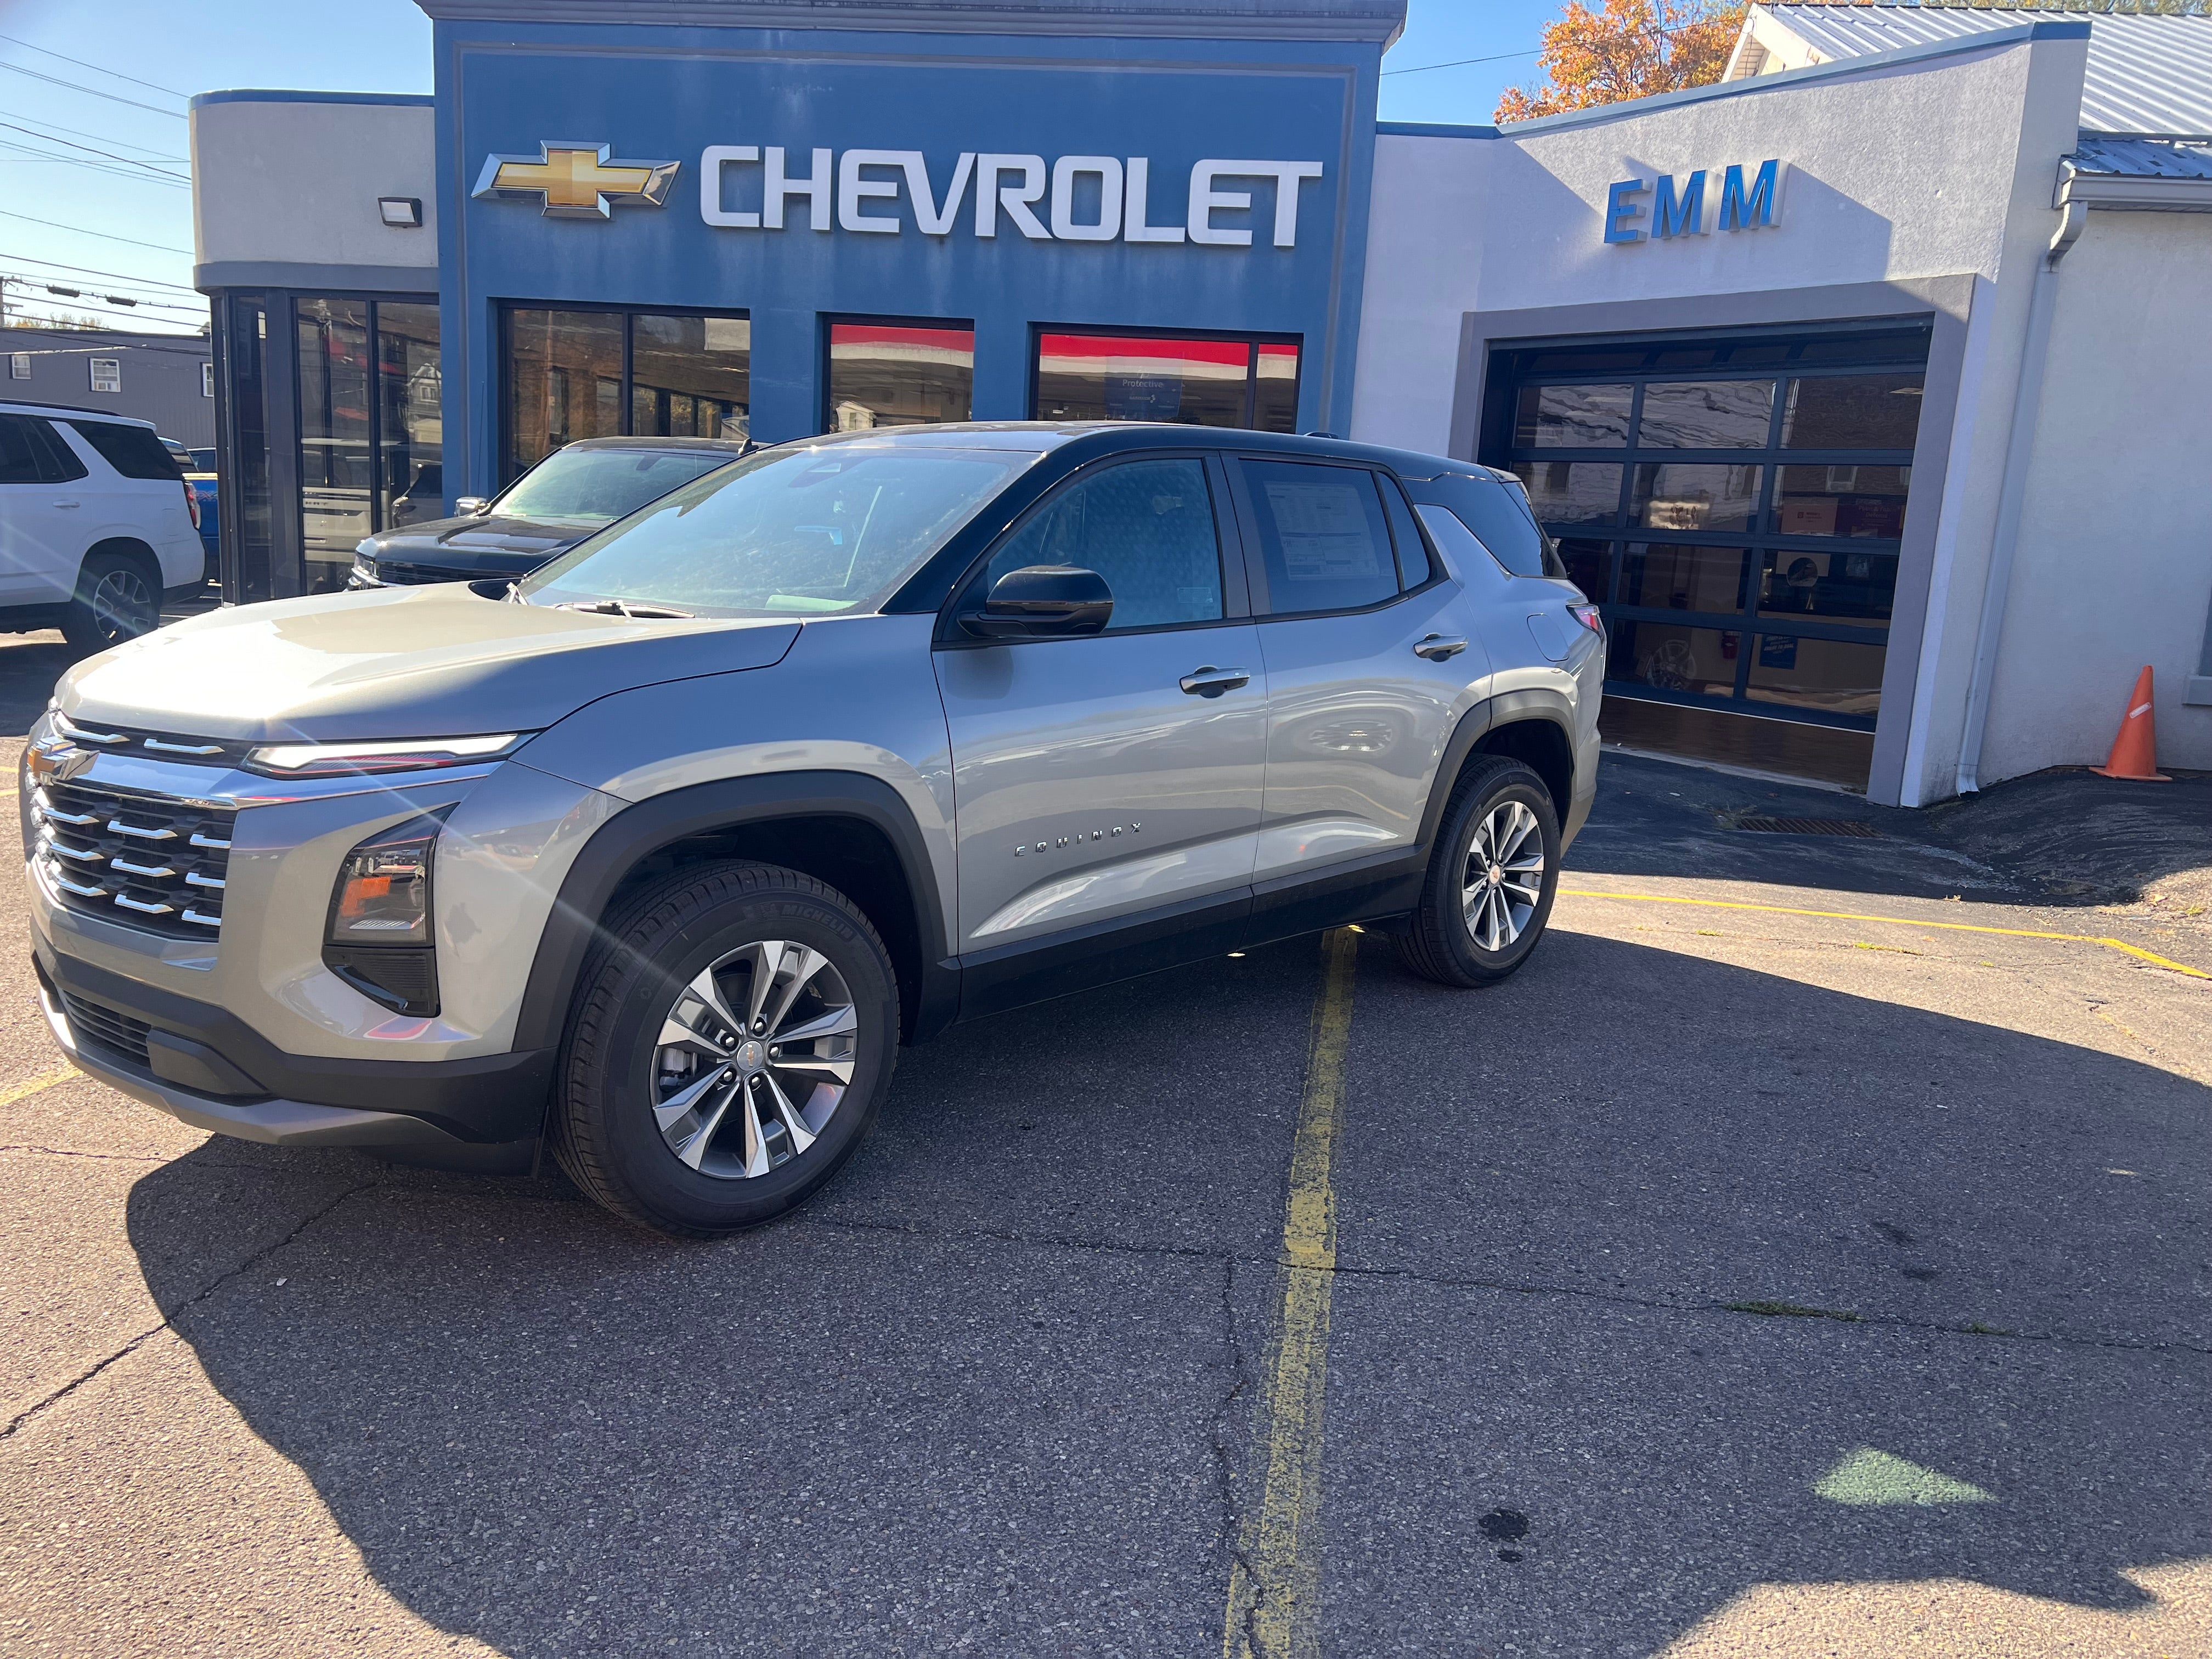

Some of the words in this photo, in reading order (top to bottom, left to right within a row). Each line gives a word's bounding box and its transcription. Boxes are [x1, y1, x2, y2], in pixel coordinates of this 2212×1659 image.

[699, 144, 1323, 247] CHEVROLET
[1604, 159, 1786, 245] EMM
[1122, 379, 1164, 388] Protective
[1015, 823, 1141, 857] EQUINOX
[781, 905, 854, 939] MICHELIN
